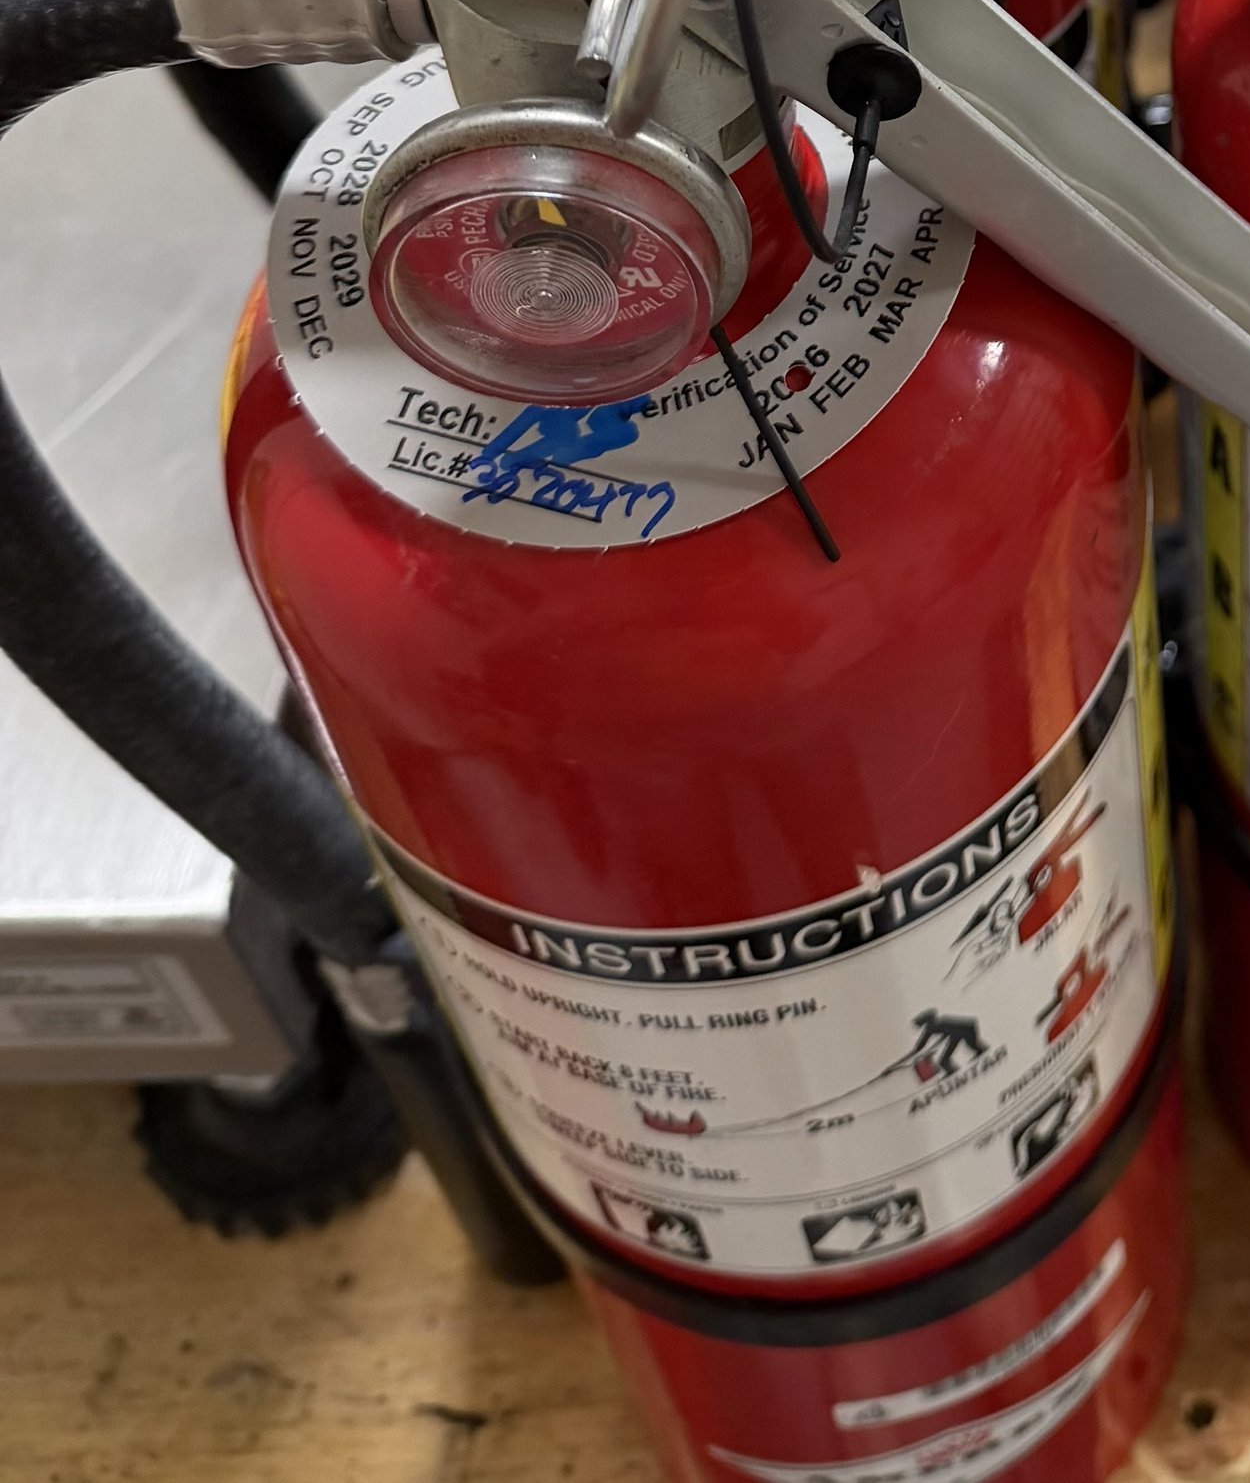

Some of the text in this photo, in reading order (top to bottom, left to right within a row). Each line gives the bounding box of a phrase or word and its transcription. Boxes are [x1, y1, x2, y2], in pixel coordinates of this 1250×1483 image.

[290, 55, 945, 468] UG SEP OCT NOV DEC JAN FEB MAR APR
[329, 139, 895, 418] 2028 2029 206 2027
[400, 386, 498, 440] Tech:
[634, 328, 799, 420] erification
[798, 293, 827, 327] of
[391, 436, 474, 479] Lic.#
[509, 792, 1041, 980] INSTRUCTIONS
[638, 1012, 704, 1030] PULL
[707, 1007, 771, 1031] RING
